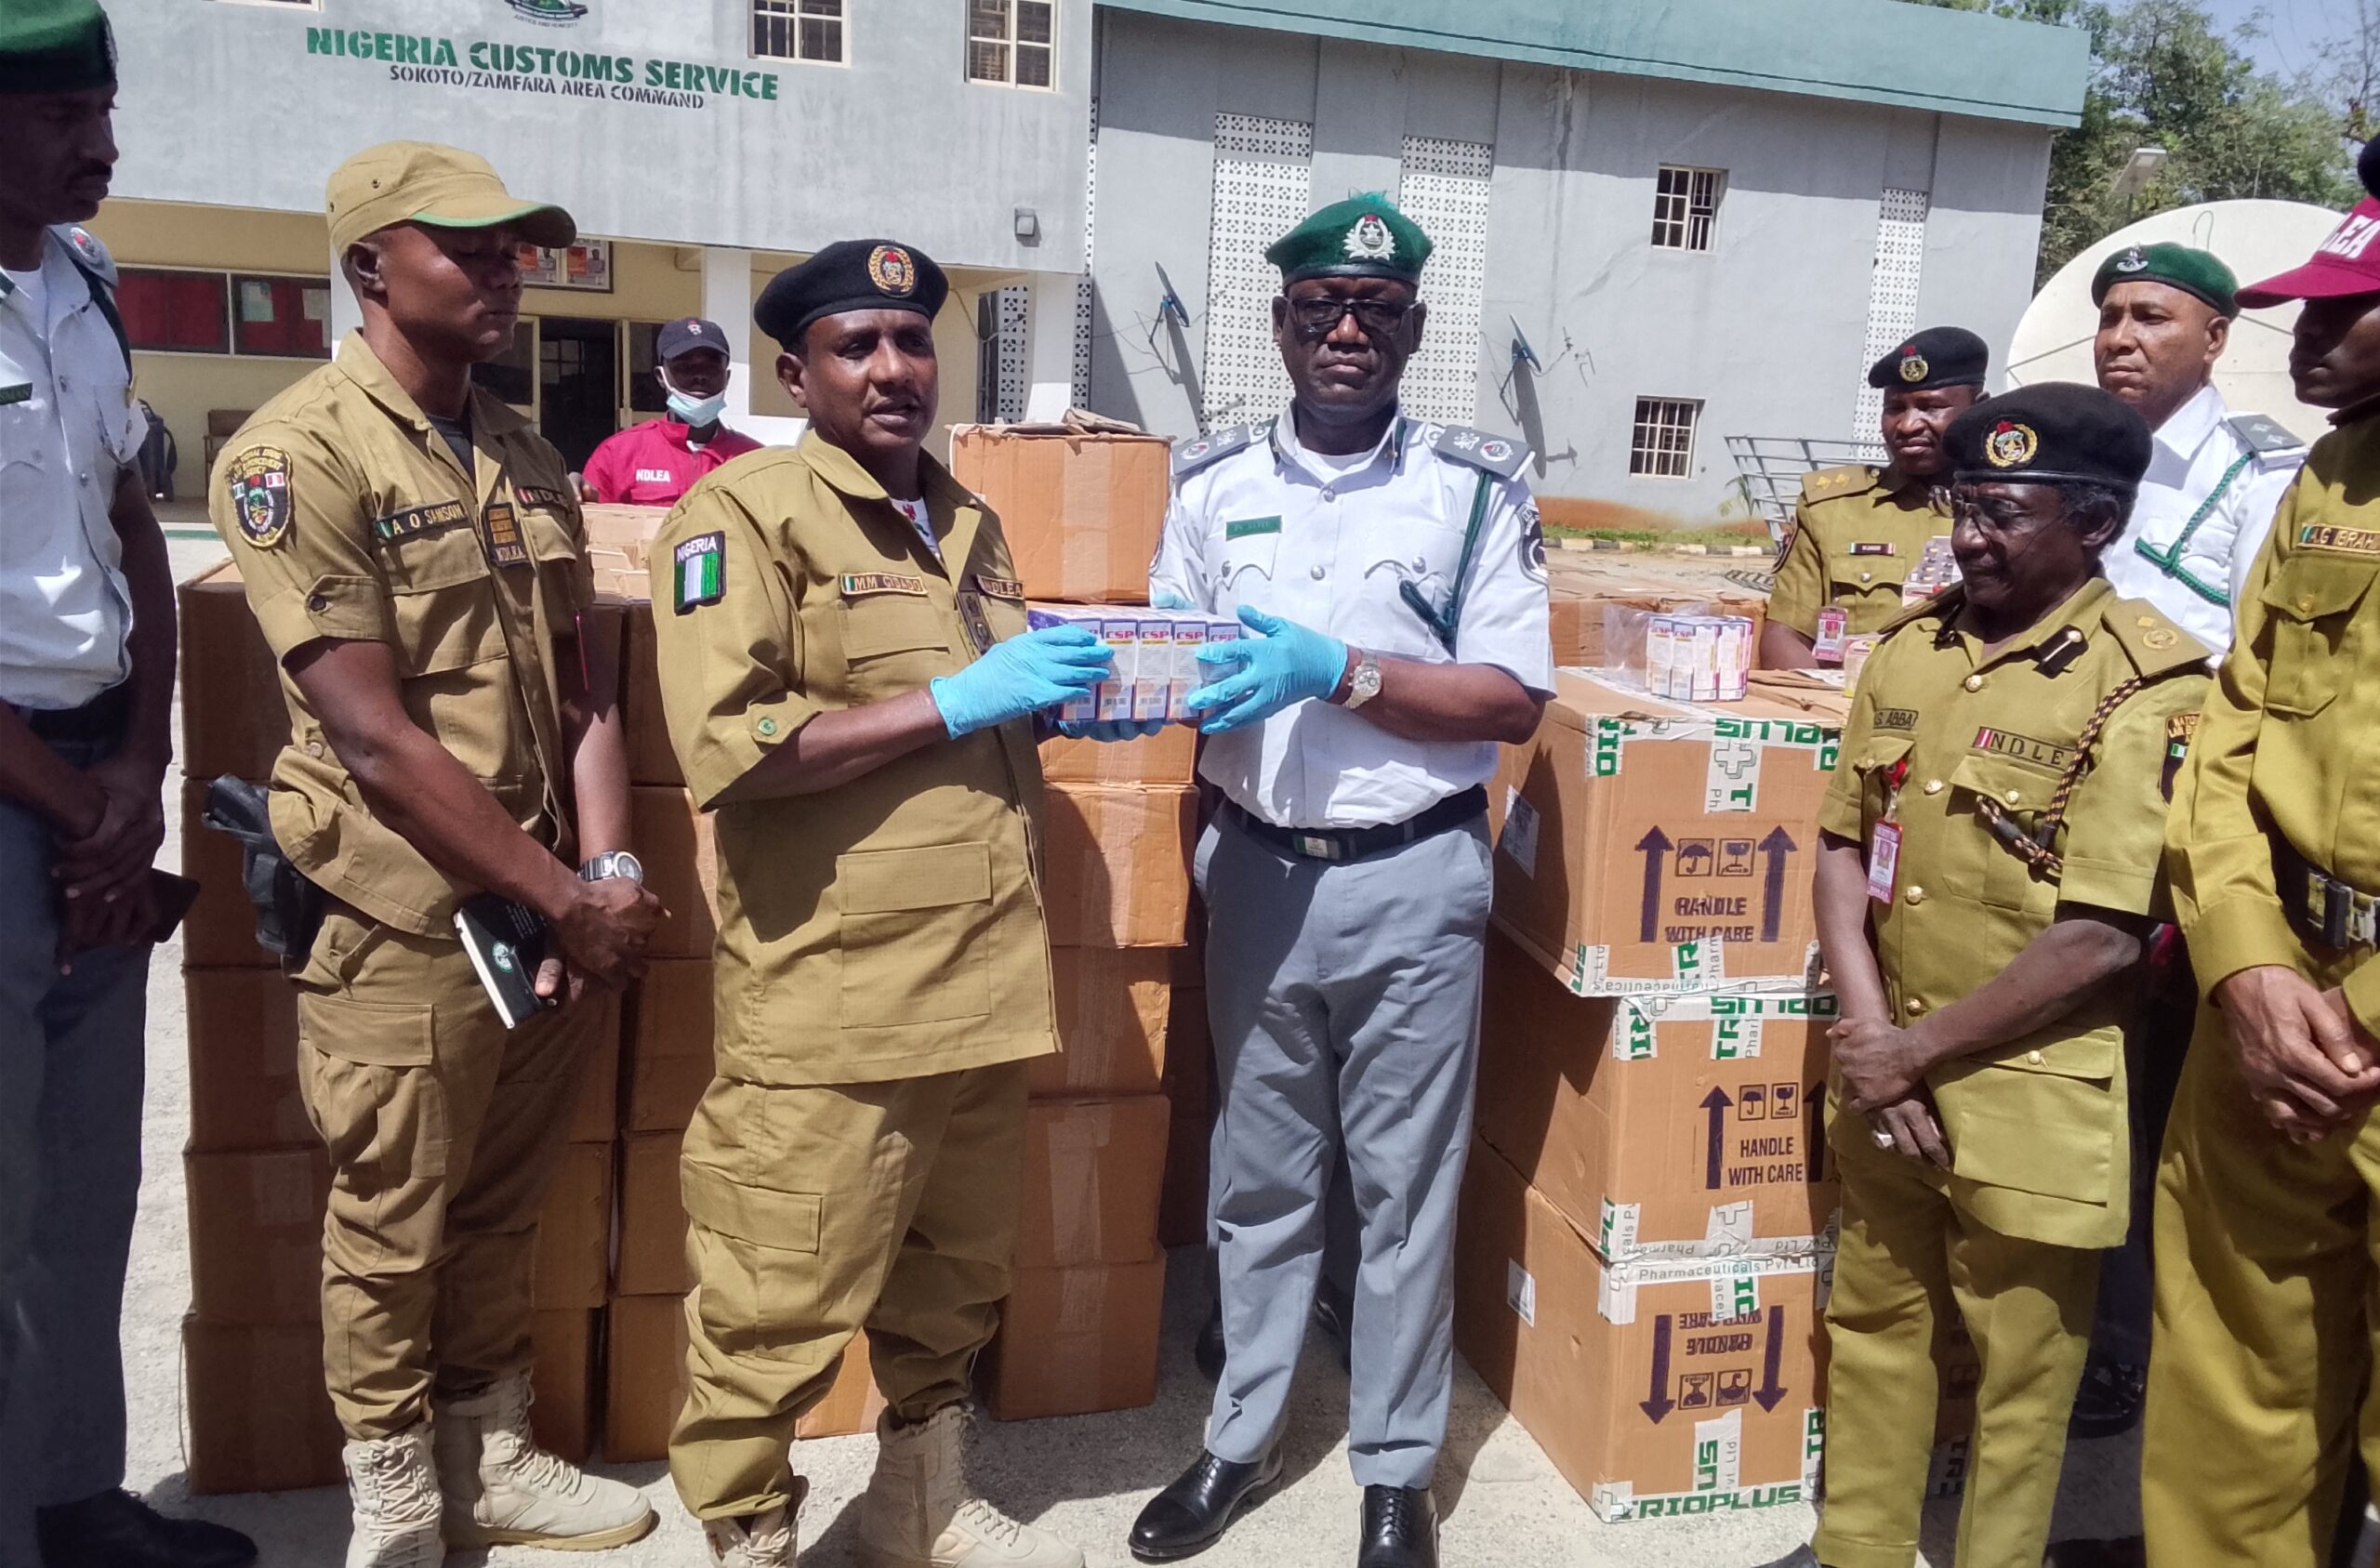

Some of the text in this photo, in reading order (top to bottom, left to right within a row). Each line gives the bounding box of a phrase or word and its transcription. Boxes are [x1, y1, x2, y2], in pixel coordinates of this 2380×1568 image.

[306, 27, 778, 100] NIGERIA CUSTOMS SERVICE
[390, 65, 704, 109] SOKOTO/ZAMFARA AREA COMMAND
[636, 468, 670, 482] NDLEA
[677, 536, 718, 561] NIGERIA
[982, 579, 1022, 596] NDLEA
[1106, 630, 1134, 639] CSP
[1142, 630, 1169, 639] CSP
[1176, 631, 1203, 639] CSP
[1990, 732, 2065, 766] NDLE
[1674, 896, 1748, 916] HANDLE
[1664, 926, 1706, 942] WITH
[1740, 1137, 1794, 1158] HANDLE
[1728, 1163, 1803, 1186] WITH CARE
[1639, 1261, 1760, 1281] Pharmaceuticals
[1686, 1333, 1753, 1355] HANDLE
